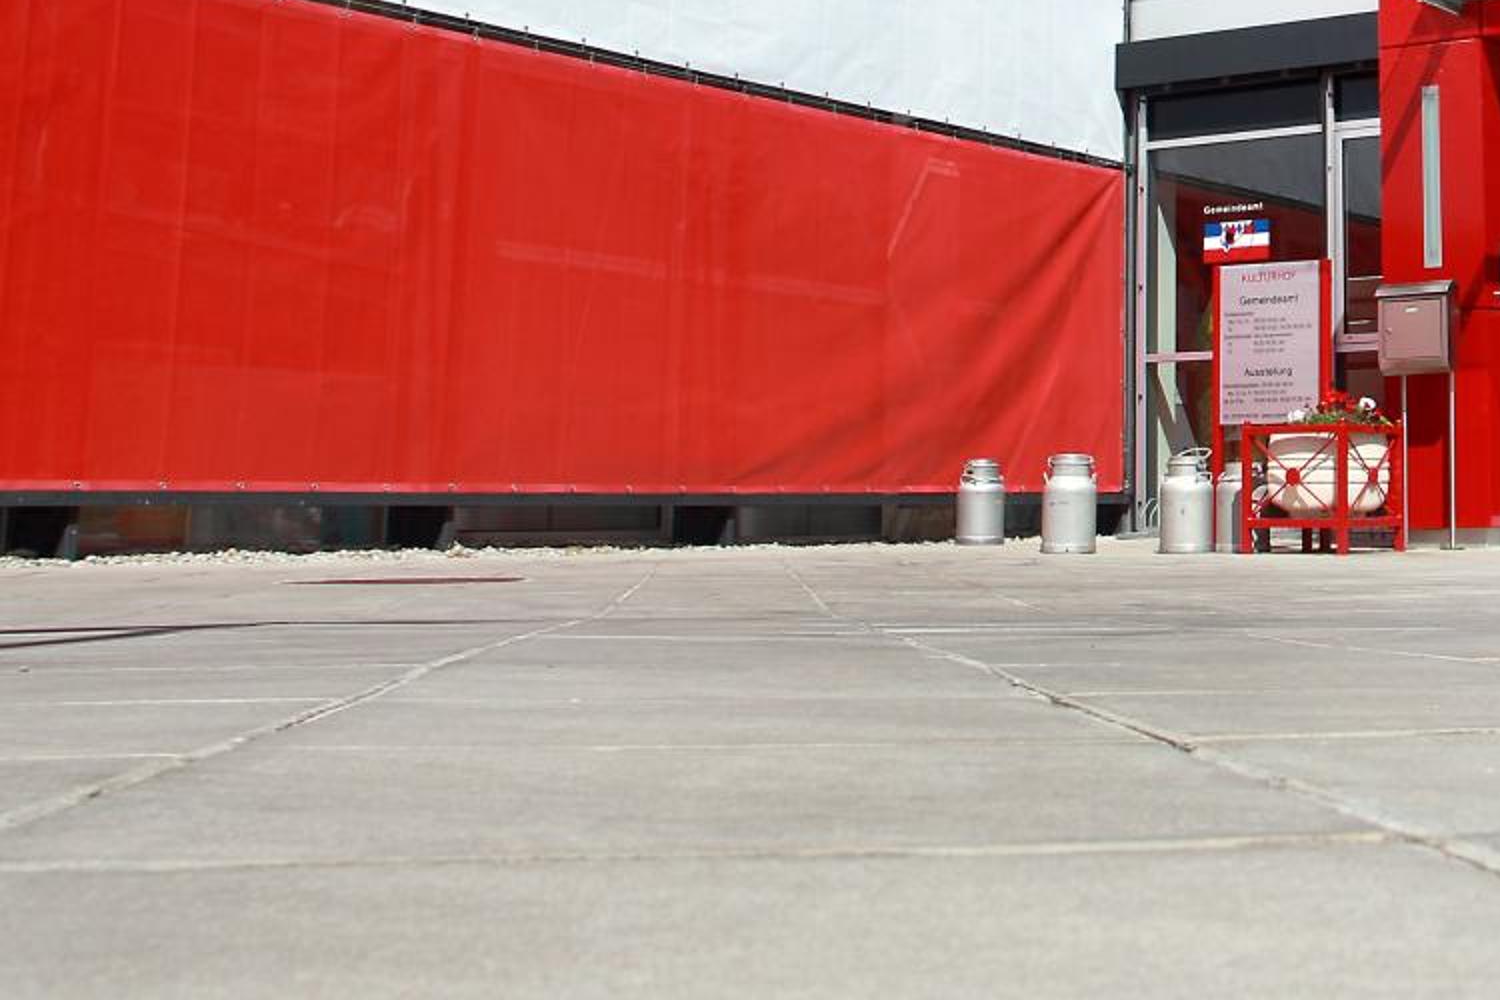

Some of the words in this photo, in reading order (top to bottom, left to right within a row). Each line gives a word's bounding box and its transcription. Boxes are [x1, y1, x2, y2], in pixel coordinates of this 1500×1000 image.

[1203, 202, 1263, 215] Gemeindeamt
[1240, 293, 1299, 305] Gemeindeamt
[1244, 366, 1293, 378] Ausstellung
